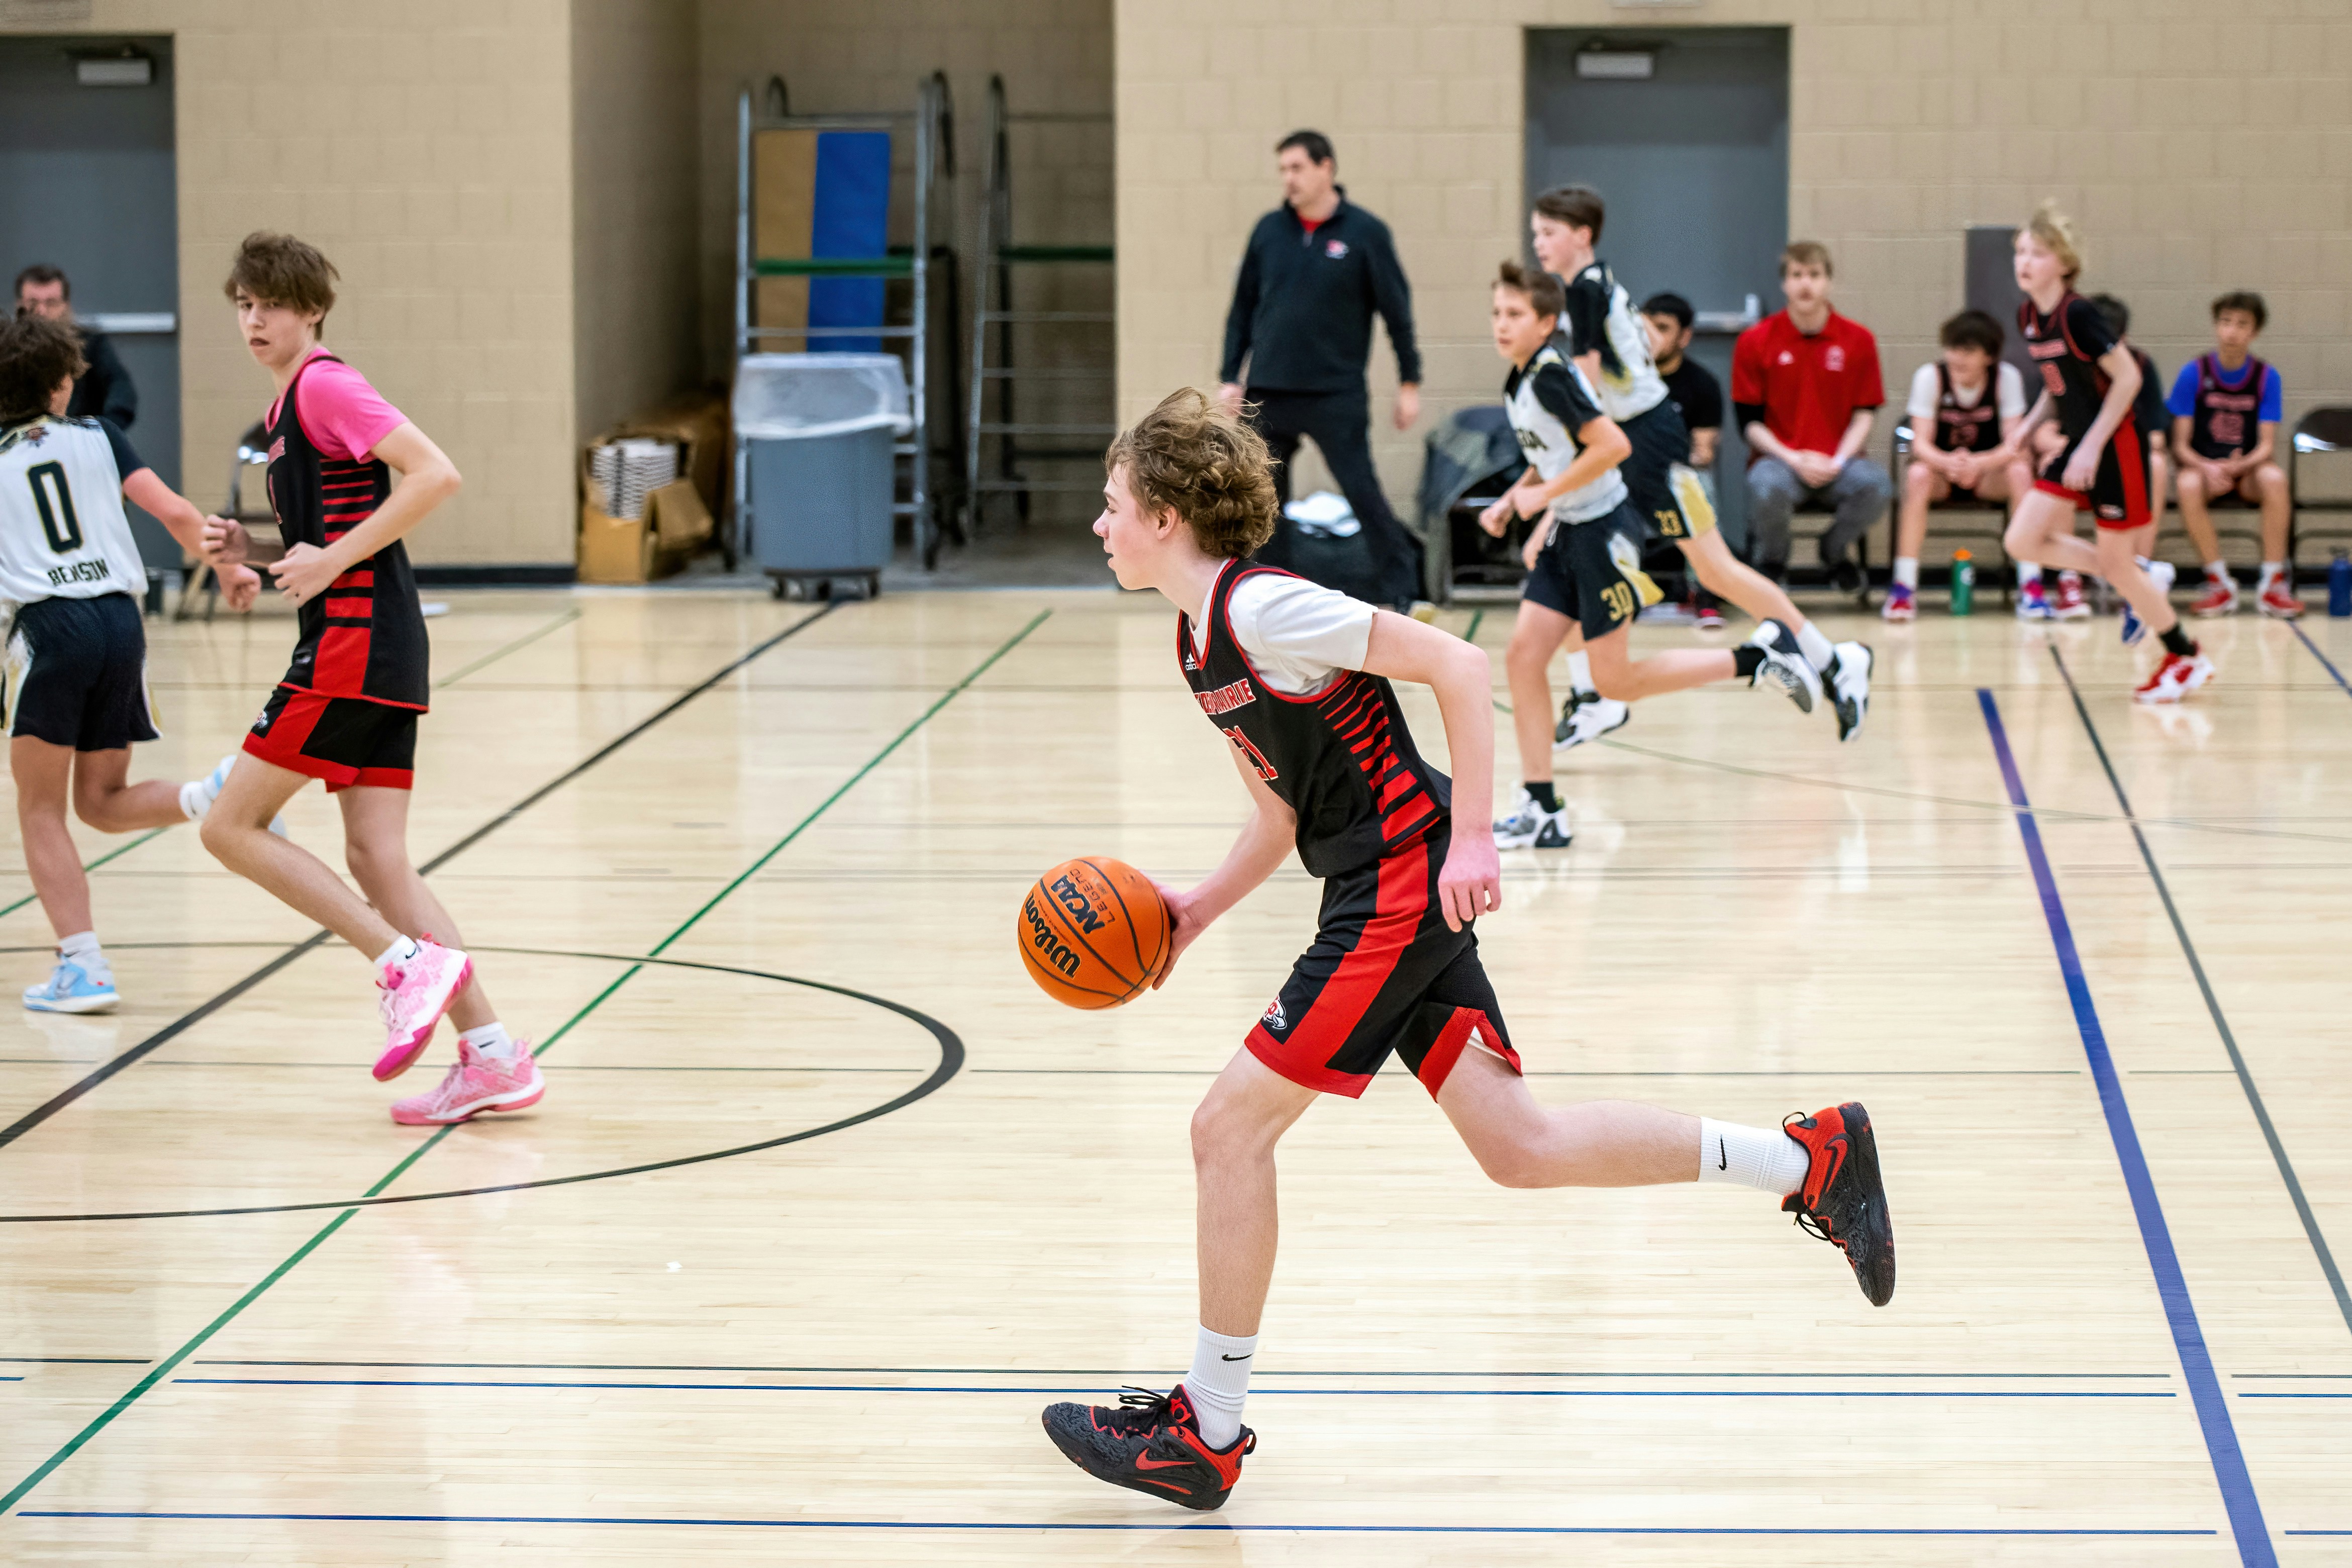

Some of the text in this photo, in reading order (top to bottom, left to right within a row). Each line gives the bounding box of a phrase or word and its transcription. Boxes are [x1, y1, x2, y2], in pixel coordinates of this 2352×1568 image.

[26, 459, 83, 555] 0
[47, 557, 112, 587] BENSON
[1600, 580, 1634, 621] 30
[1051, 874, 1106, 934] NCAA
[1069, 868, 1116, 923] LEGEND
[1025, 892, 1082, 979] Wilson
